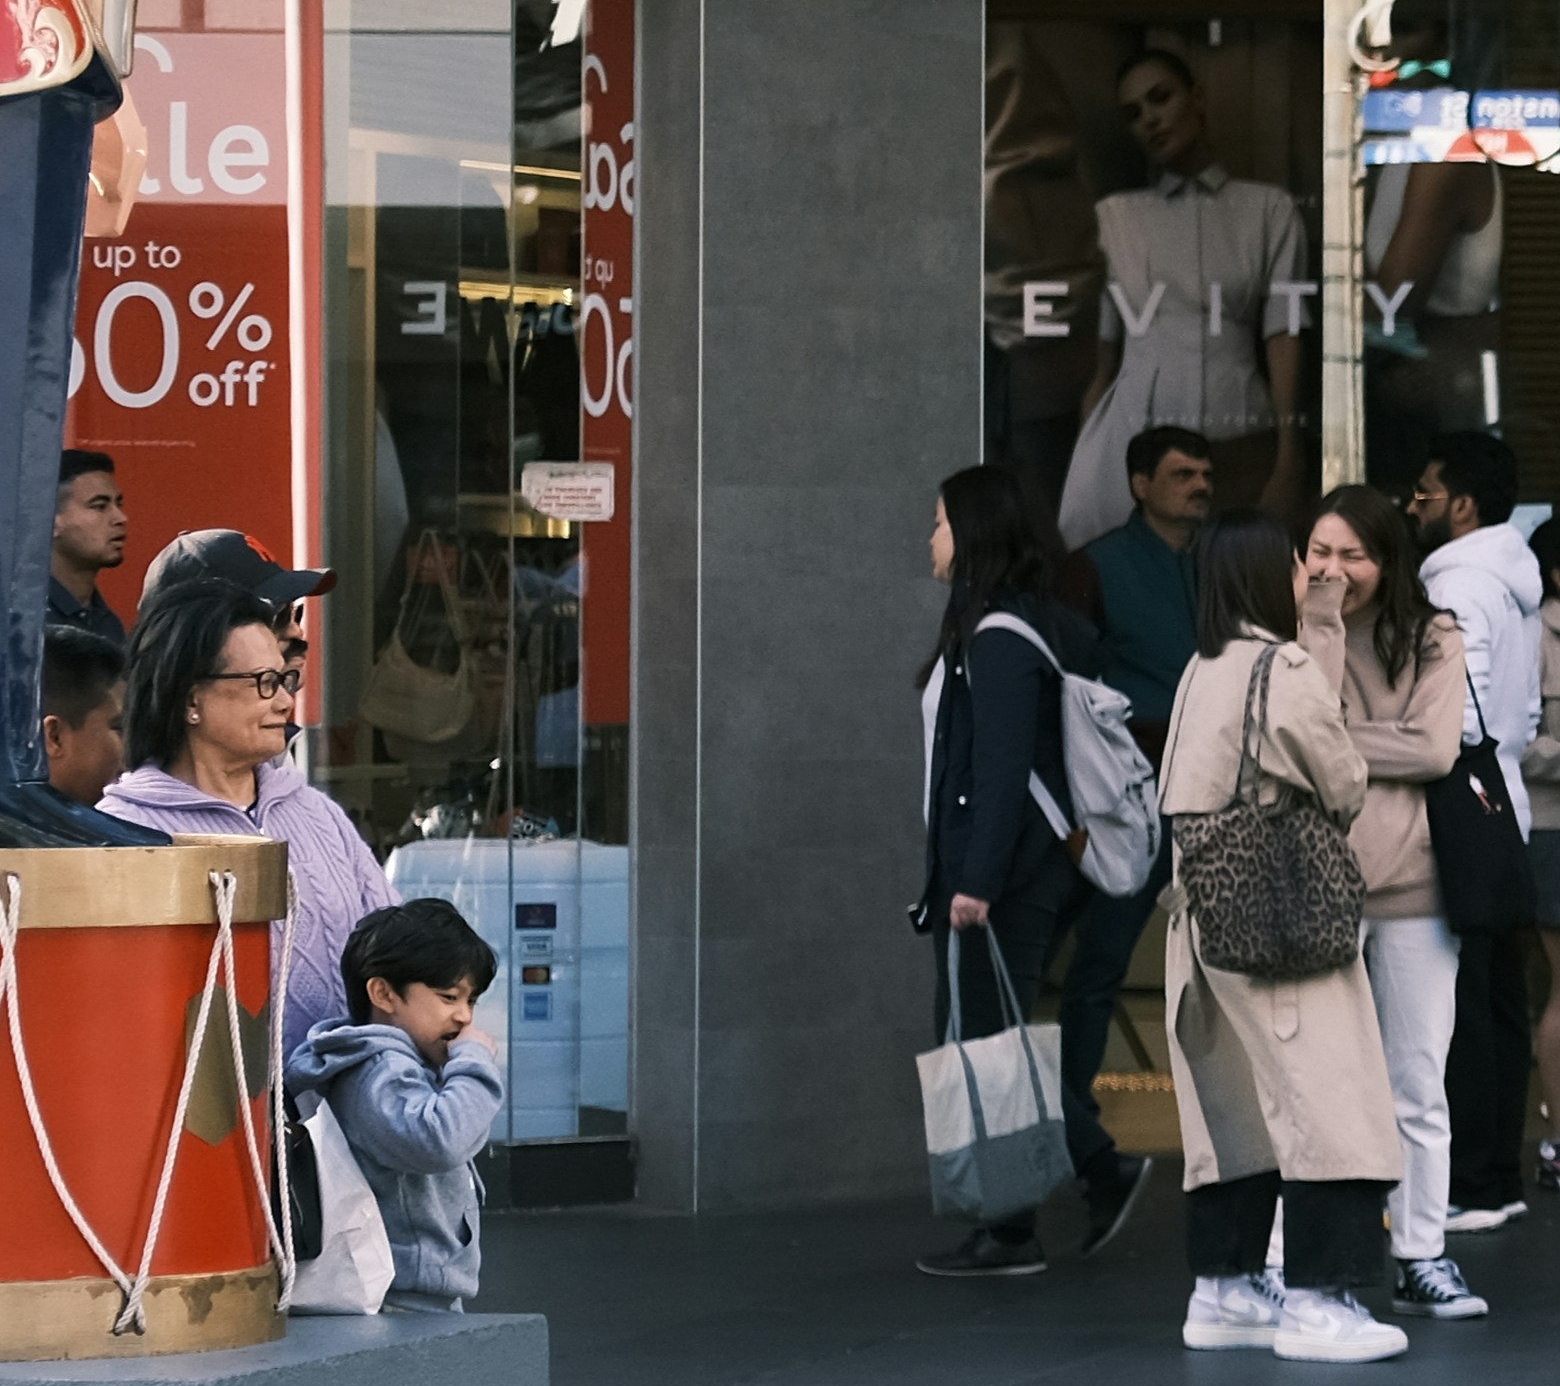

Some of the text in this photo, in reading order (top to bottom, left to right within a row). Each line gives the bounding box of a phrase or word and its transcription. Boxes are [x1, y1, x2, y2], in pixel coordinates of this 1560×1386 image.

[137, 101, 270, 195] le
[93, 241, 182, 276] up to
[1023, 281, 1415, 337] EVITY
